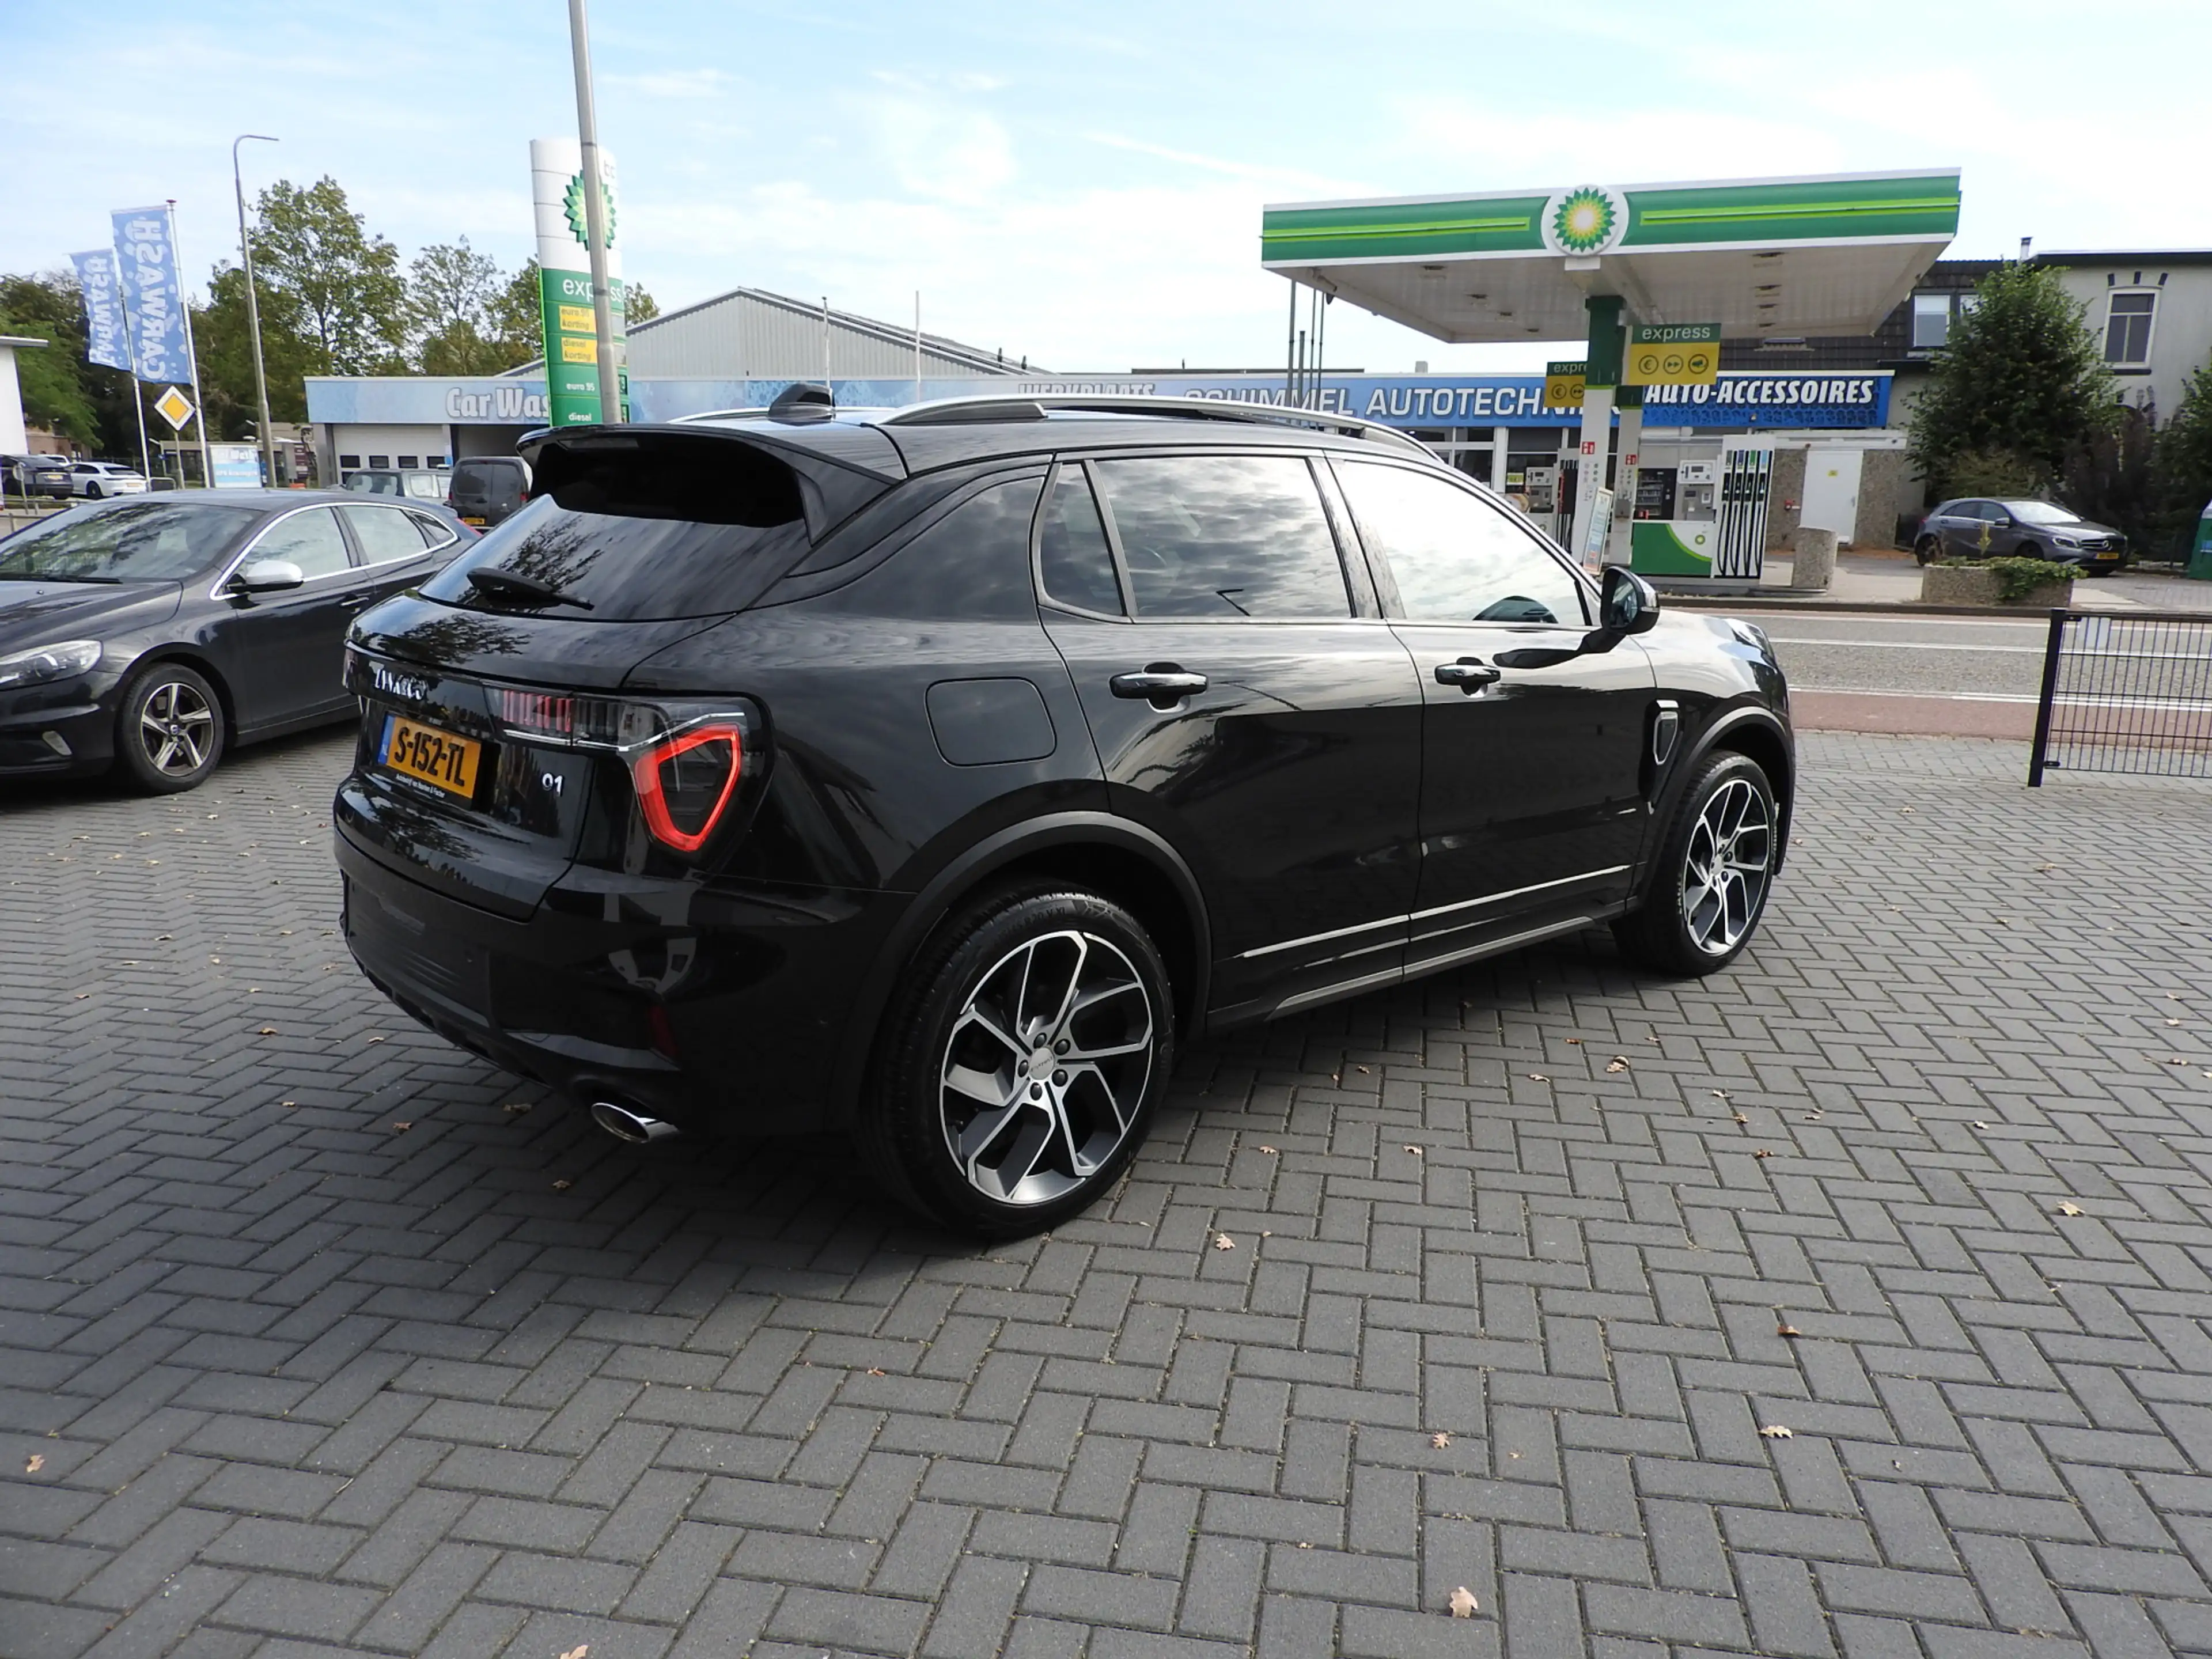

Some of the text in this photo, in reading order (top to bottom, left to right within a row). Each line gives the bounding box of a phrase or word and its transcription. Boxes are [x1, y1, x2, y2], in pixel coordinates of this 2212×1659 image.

[563, 279, 623, 304] expss
[1642, 327, 1710, 343] express
[1554, 363, 1588, 376] expr
[566, 382, 595, 392] euro 95
[446, 387, 550, 419] Car Was
[1365, 388, 1620, 416] AUTOTECH
[569, 412, 592, 421] diesel
[393, 726, 465, 787] S-152-TL
[542, 772, 563, 796] 01
